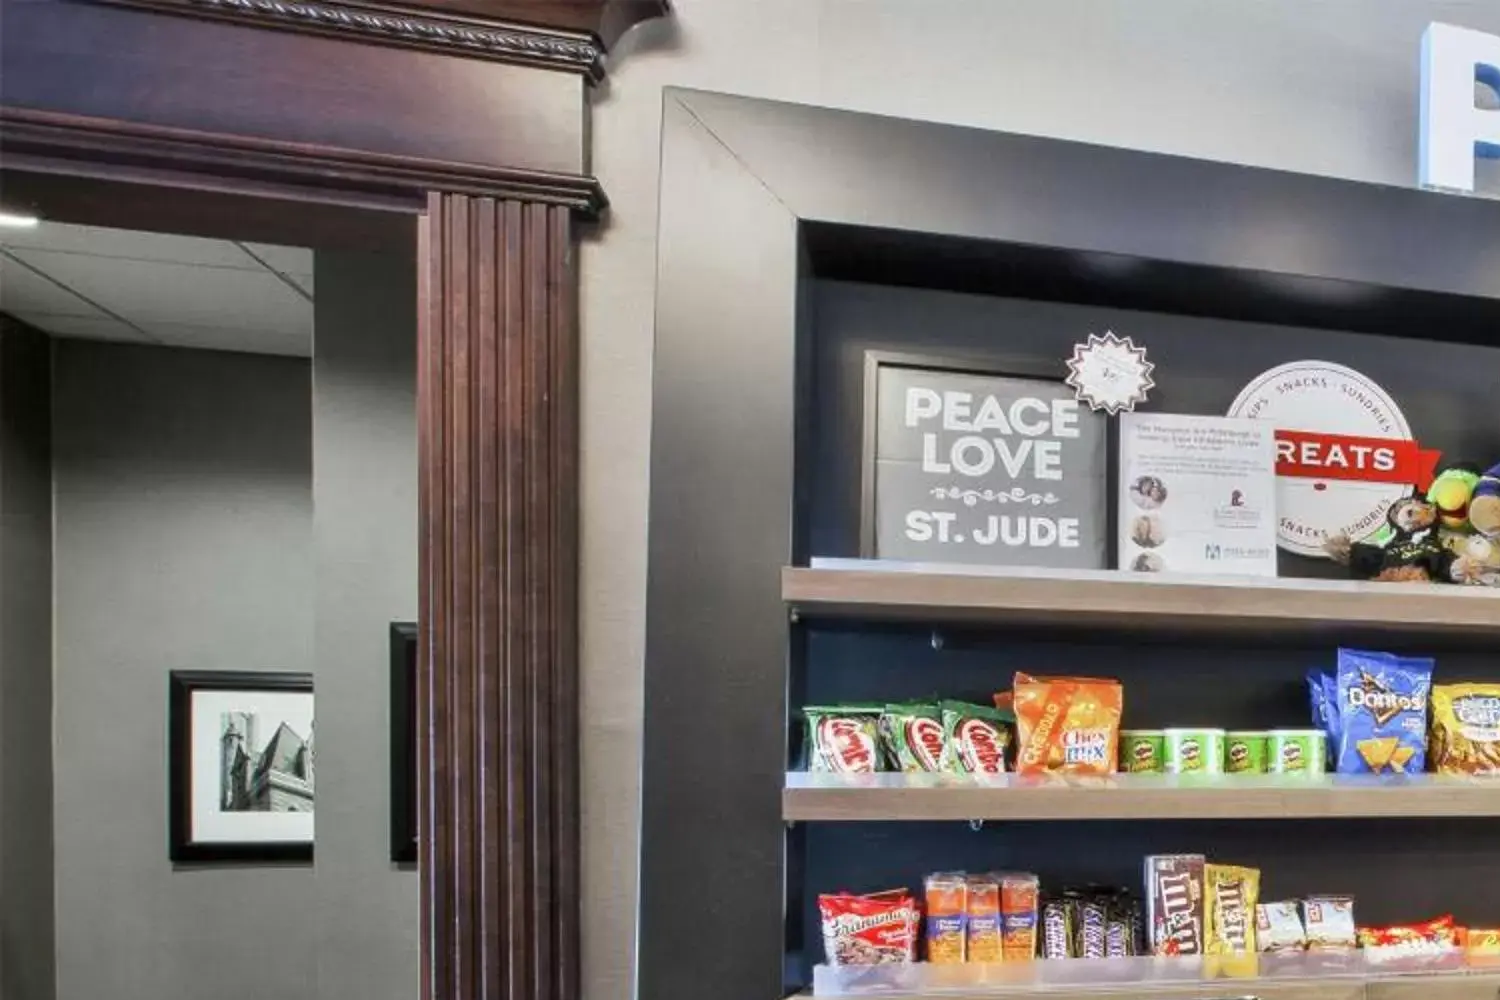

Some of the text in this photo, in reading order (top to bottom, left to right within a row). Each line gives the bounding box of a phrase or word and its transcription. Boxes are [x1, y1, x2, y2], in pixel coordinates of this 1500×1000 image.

[903, 387, 1081, 438] PEACE
[1275, 376, 1329, 395] SNACKS
[1341, 383, 1393, 433] SUNDRIES
[922, 433, 1063, 480] LOVE
[1274, 438, 1397, 472] REATS
[904, 508, 1080, 548] ST. JUDE
[1279, 516, 1329, 538] SNACKS
[1349, 687, 1426, 712] Doritos
